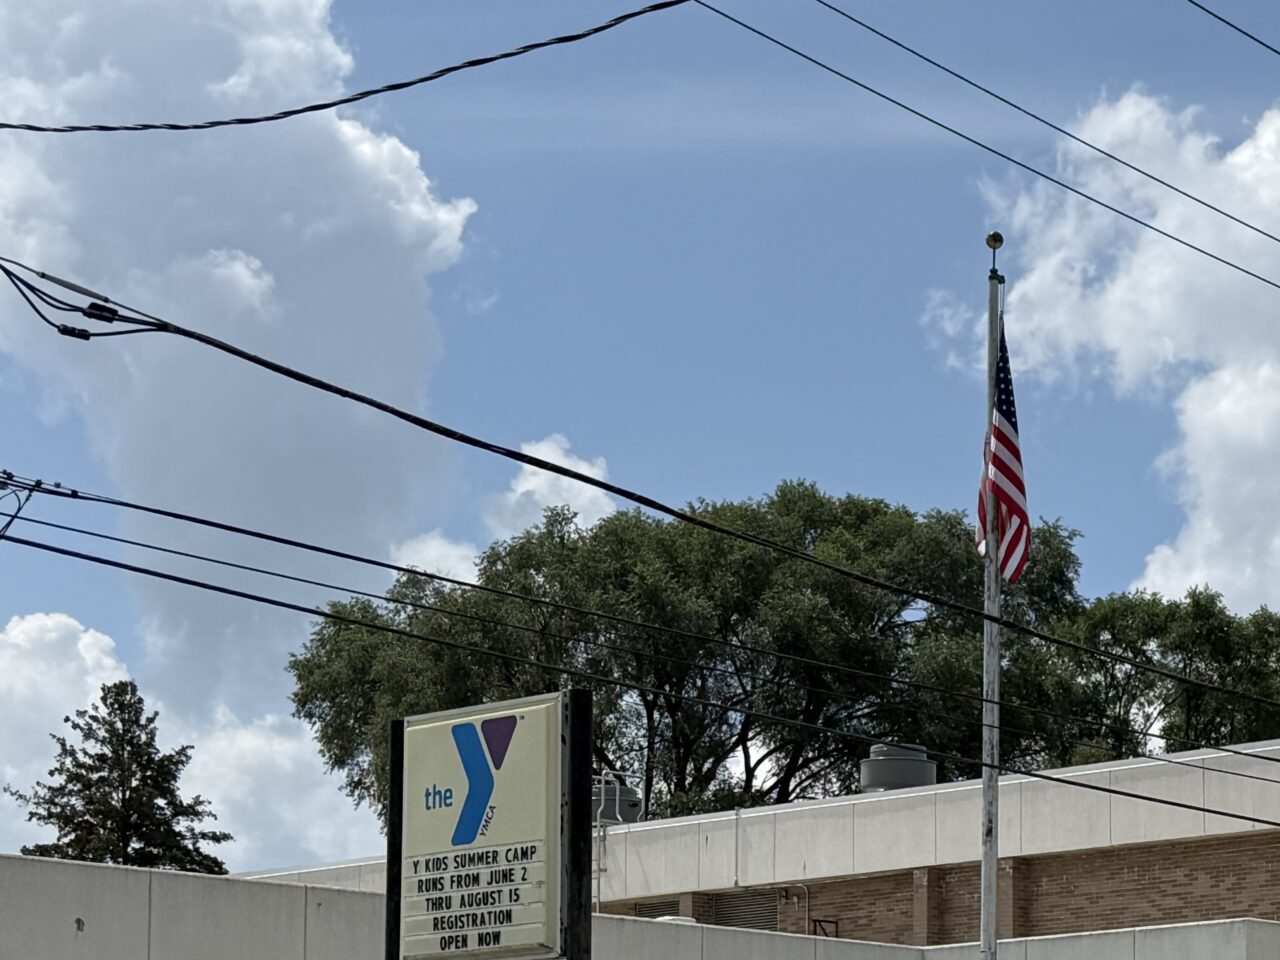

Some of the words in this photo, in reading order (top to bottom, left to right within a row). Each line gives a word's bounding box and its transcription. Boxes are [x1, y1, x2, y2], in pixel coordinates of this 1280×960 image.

[425, 784, 453, 810] the
[479, 805, 496, 837] YMCA
[413, 860, 419, 874] Y
[425, 856, 448, 873] KIDS
[454, 851, 498, 869] SUMMER
[505, 845, 537, 862] CAMP
[418, 875, 444, 893] RUNS
[451, 872, 480, 890] FROM
[487, 868, 515, 885] JUNE
[521, 867, 527, 881] 2
[425, 894, 451, 912] THRU
[459, 890, 502, 908] AUGUST
[509, 888, 520, 903] 15
[433, 909, 512, 931] REGISTRATION
[440, 934, 468, 951] OPEN
[478, 931, 501, 947] NOW
